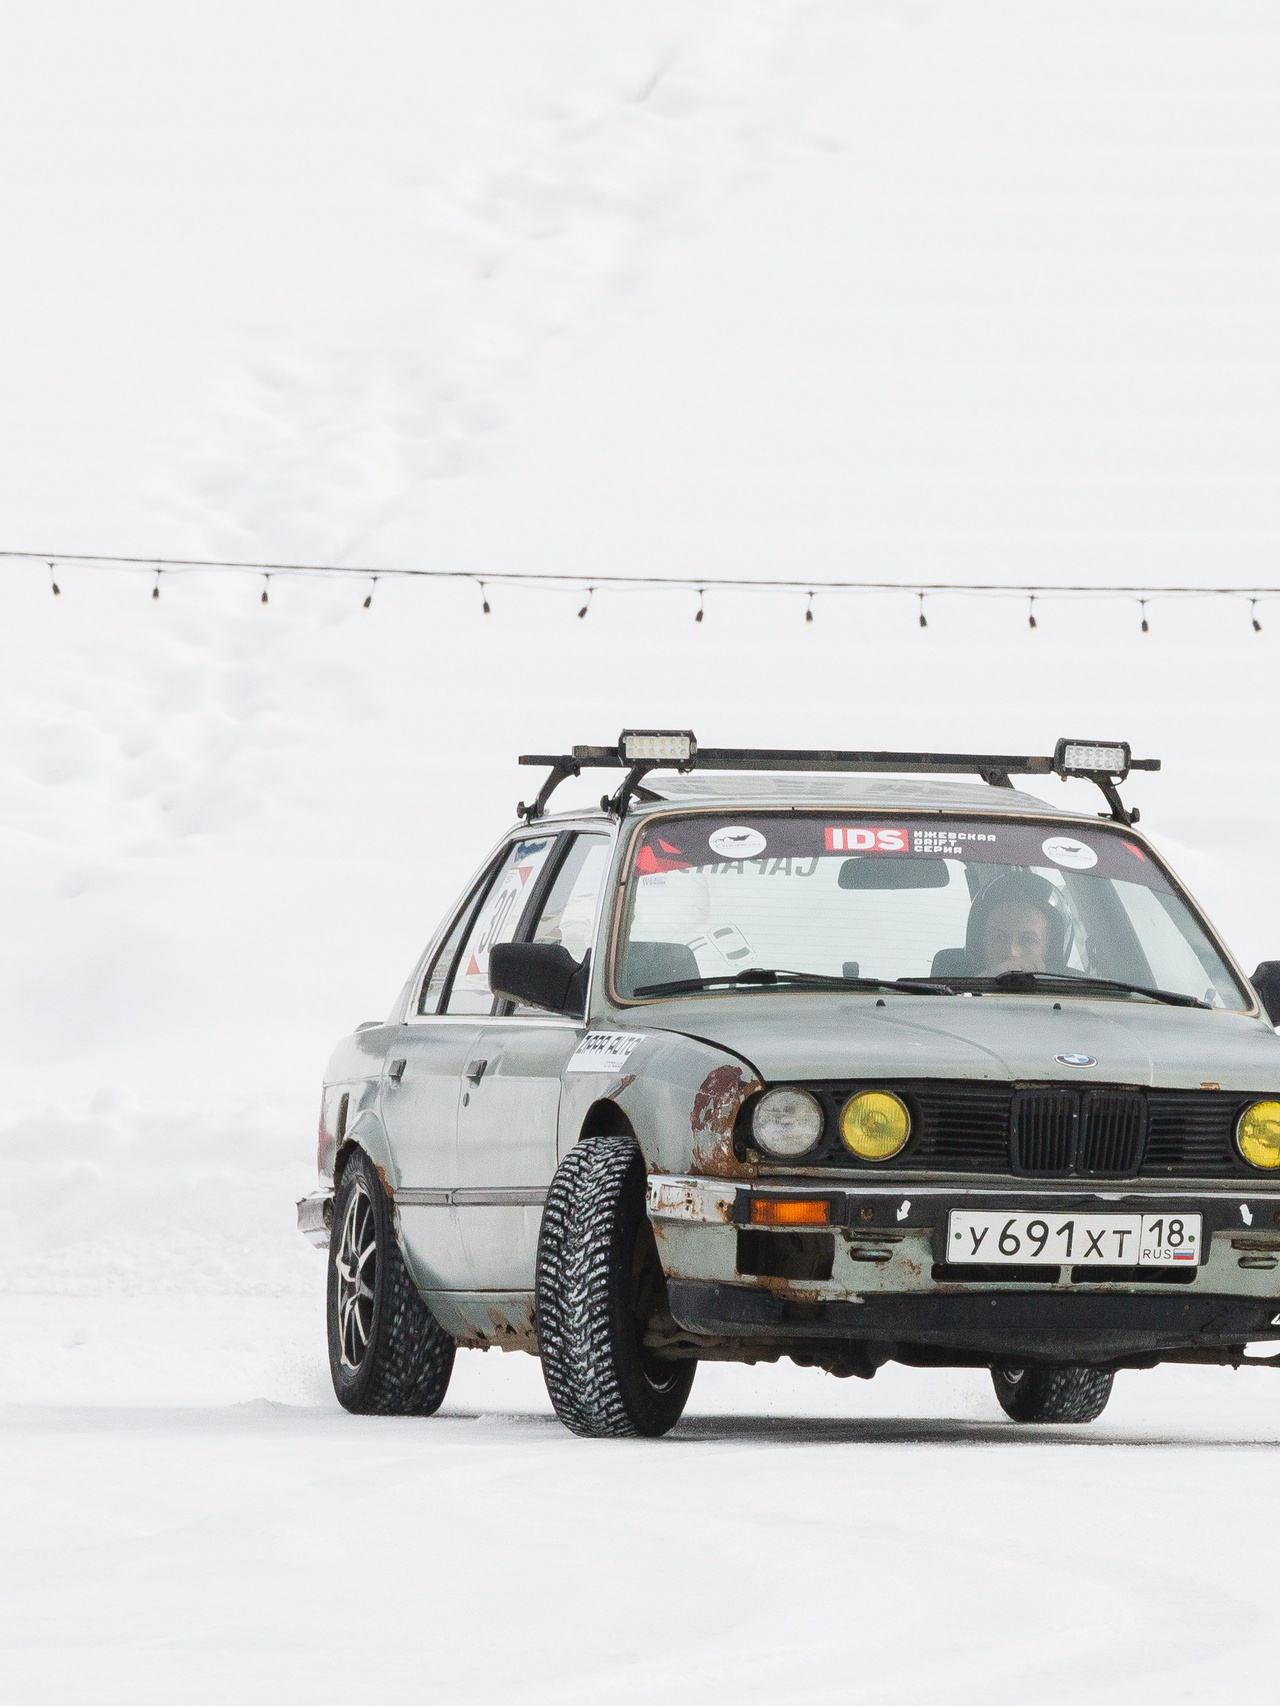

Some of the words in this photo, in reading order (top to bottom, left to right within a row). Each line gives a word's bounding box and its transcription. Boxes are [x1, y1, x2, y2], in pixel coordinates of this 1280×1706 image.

[832, 828, 904, 850] IDS
[914, 831, 996, 841] ИЖЕВСКАЯ
[914, 838, 957, 846] DRIFT
[914, 845, 962, 854] СЕРИЯ
[576, 1035, 612, 1054] ZIPPA
[605, 1036, 641, 1055] AUTO
[1148, 1219, 1184, 1247] 18
[1143, 1249, 1171, 1259] RUS
